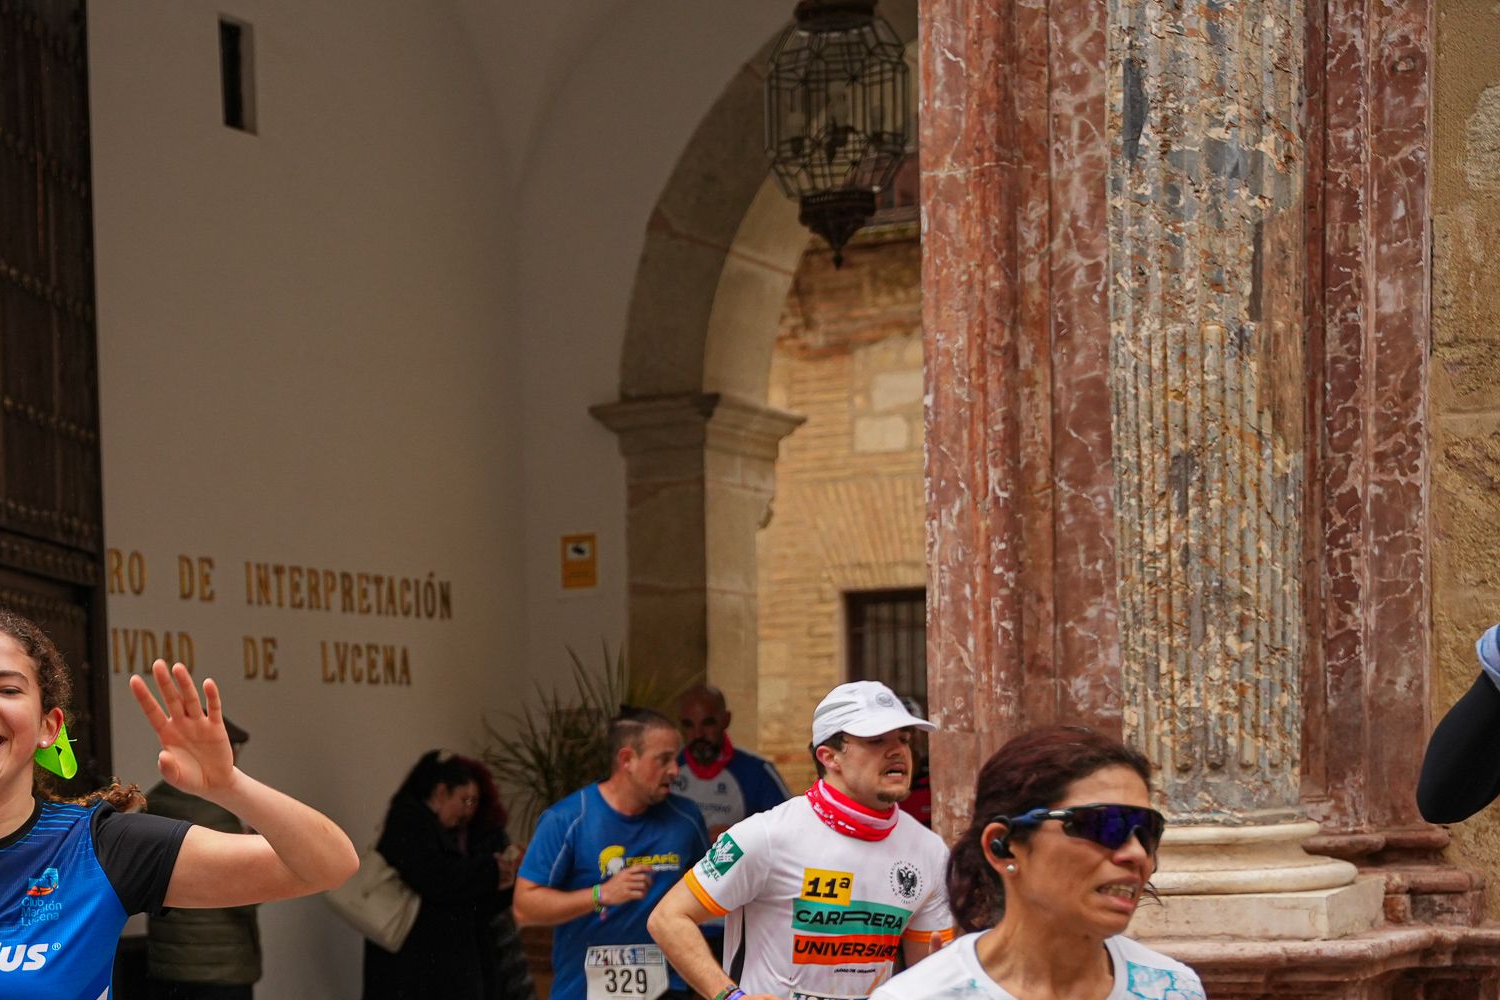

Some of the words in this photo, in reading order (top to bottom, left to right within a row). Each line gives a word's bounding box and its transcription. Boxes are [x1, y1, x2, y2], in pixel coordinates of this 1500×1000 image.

[178, 554, 216, 602] DE
[245, 560, 453, 620] INTERPRETACIÓN
[243, 636, 279, 681] DE
[320, 640, 413, 687] LVCENA
[21, 896, 45, 908] Club
[21, 901, 63, 918] Maratón
[795, 910, 903, 930] CARRERA
[604, 968, 648, 994] 329
